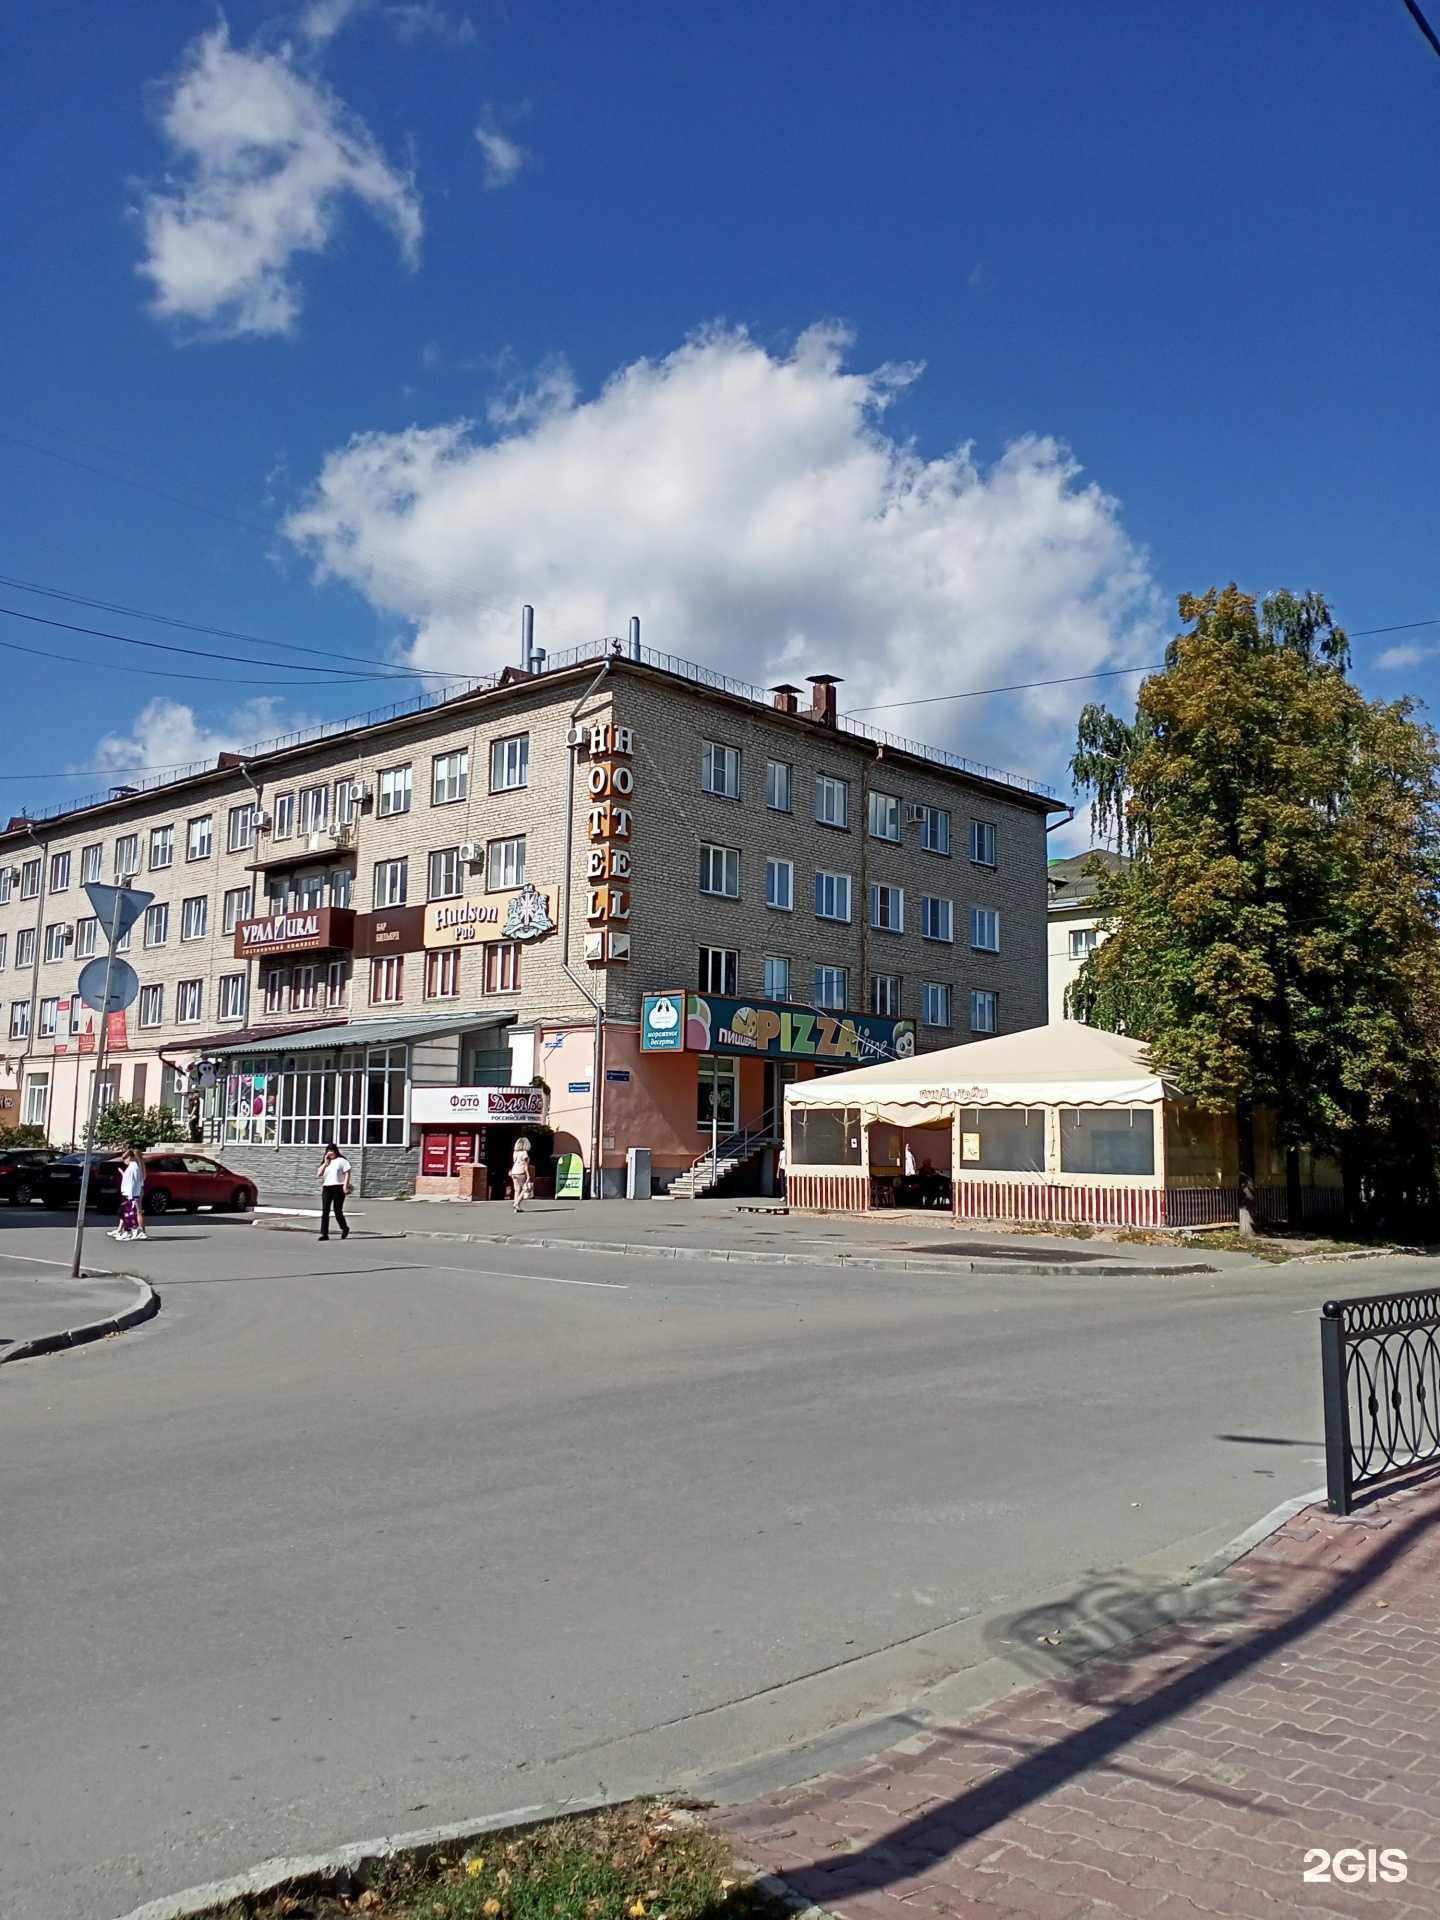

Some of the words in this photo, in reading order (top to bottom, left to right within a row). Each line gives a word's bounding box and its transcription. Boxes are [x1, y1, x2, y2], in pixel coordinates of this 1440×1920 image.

[587, 726, 607, 919] HOTEL
[609, 727, 634, 919] HOTEL
[287, 915, 321, 938] URAL
[435, 901, 499, 931] Hudson
[242, 922, 274, 944] УРАЛ
[455, 925, 476, 941] Pub
[756, 1009, 857, 1057] PIZZA
